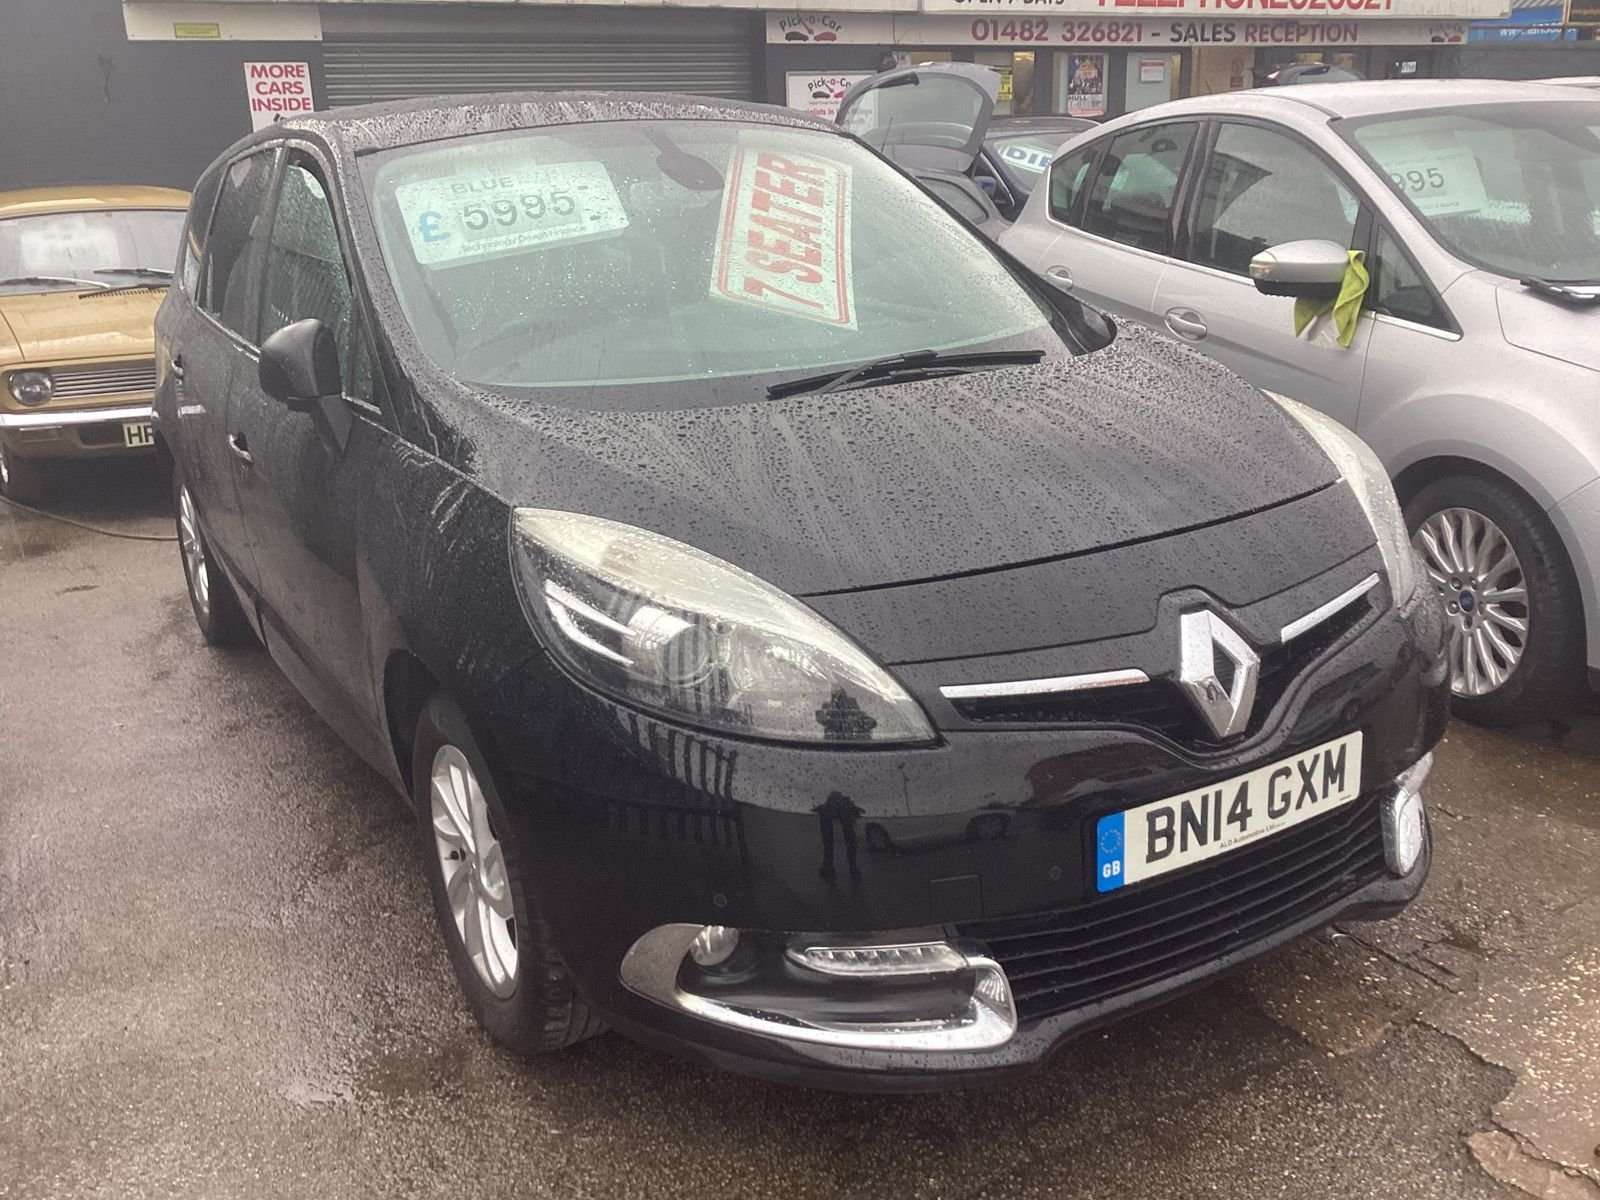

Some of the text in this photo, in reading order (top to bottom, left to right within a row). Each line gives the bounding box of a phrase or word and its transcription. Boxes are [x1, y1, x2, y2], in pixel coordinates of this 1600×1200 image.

[971, 18, 1049, 42] 01482
[1061, 18, 1143, 43] 326821
[1170, 22, 1236, 43] SALES
[1244, 21, 1359, 43] RECEPTION
[251, 64, 305, 78] MORE
[255, 81, 304, 95] CARS
[252, 97, 312, 111] INSIDE
[451, 176, 514, 193] BLUE
[463, 191, 575, 230] 5995
[744, 152, 828, 310] 7 SEATER
[1145, 742, 1348, 864] BN14 GXM
[1102, 859, 1121, 878] GB
